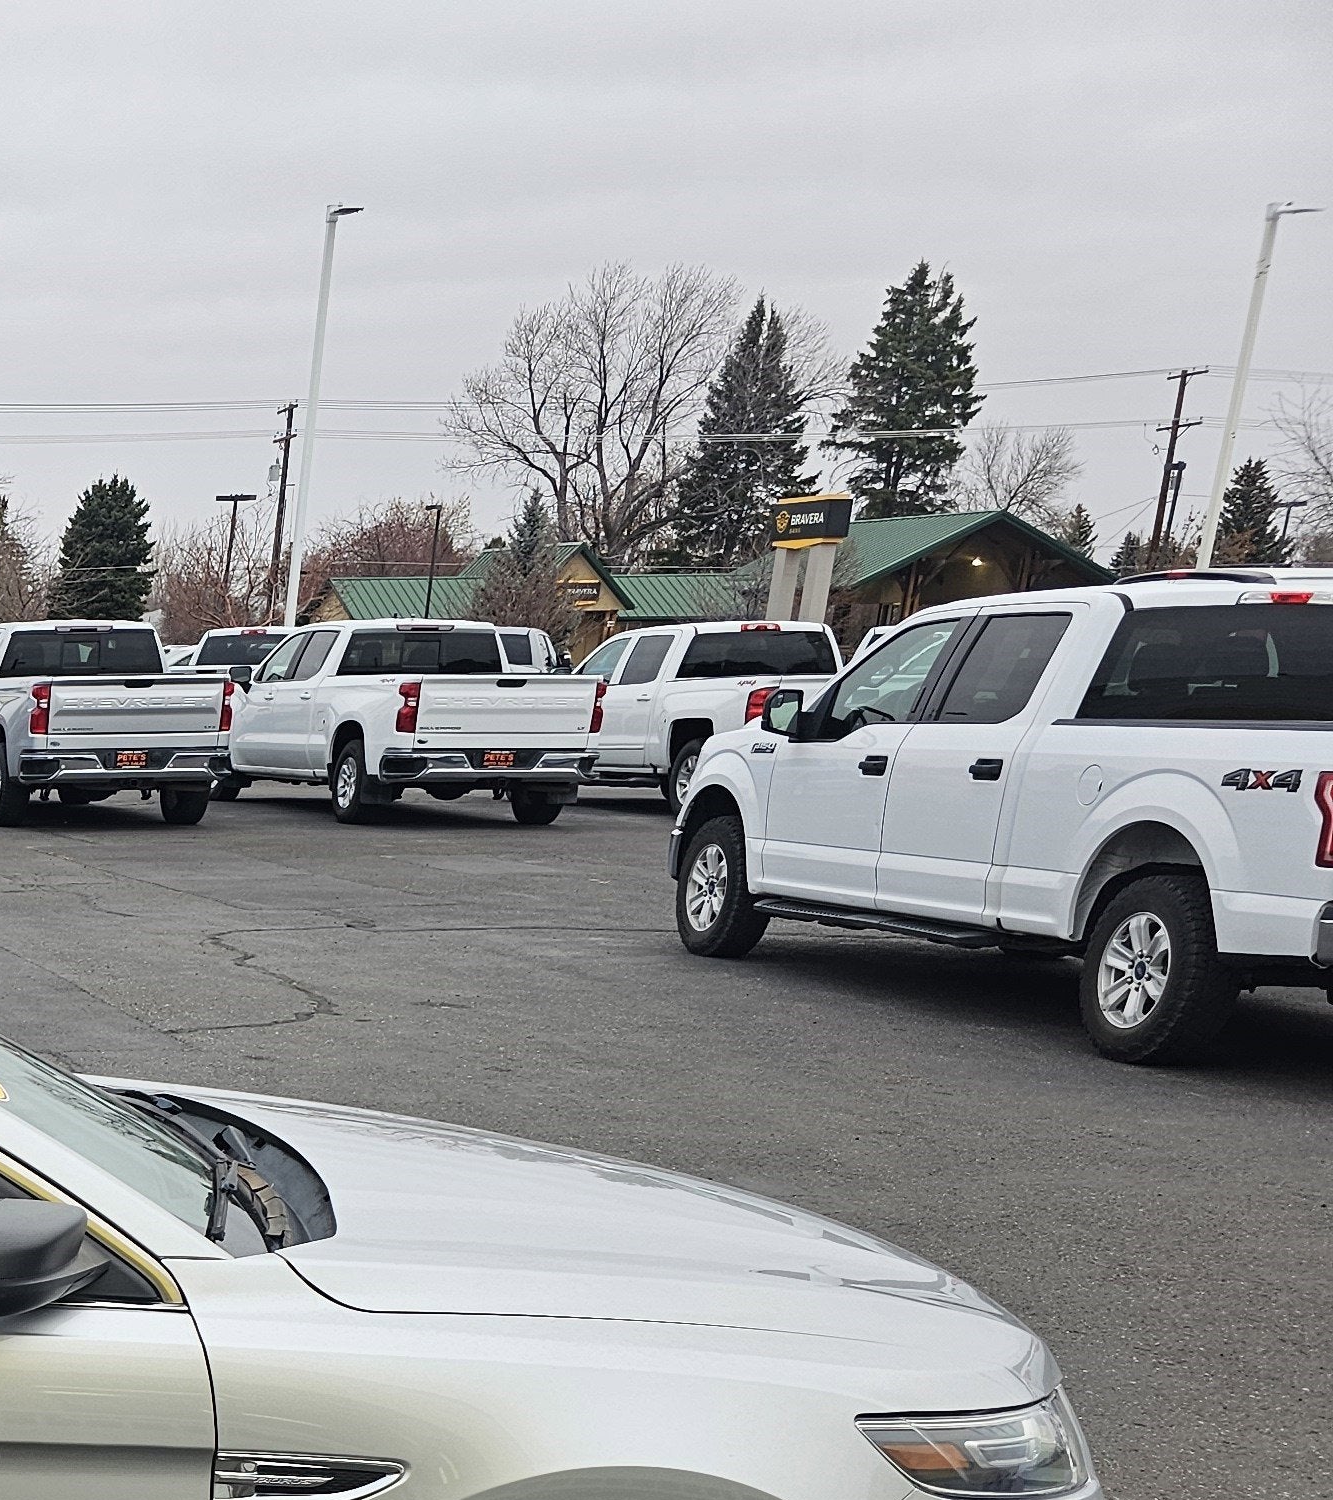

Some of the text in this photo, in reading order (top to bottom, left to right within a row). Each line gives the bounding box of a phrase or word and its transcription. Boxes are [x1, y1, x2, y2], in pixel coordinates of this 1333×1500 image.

[790, 512, 824, 526] BRAVERA
[62, 696, 213, 709] CHEVROLET
[433, 697, 582, 707] CHEVROLET
[116, 753, 147, 763] PETE'S
[484, 753, 514, 761] PETE'S
